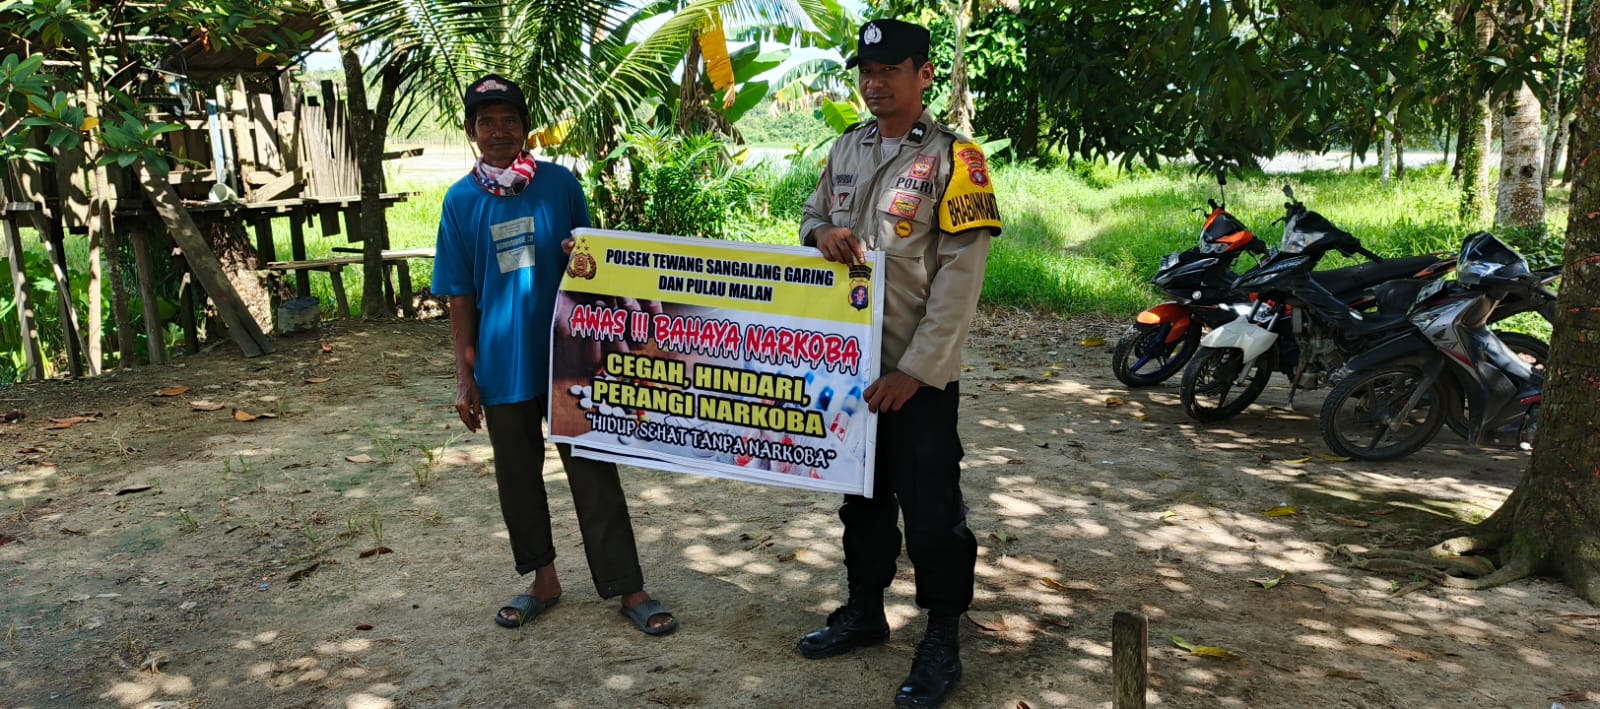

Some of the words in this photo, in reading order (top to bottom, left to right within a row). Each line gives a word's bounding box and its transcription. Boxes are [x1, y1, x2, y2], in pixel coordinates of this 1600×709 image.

[896, 177, 933, 194] POLRI
[606, 249, 650, 267] POLSEK
[653, 254, 703, 273] TEWANG
[706, 259, 781, 280] SANGALANG
[784, 267, 834, 286] GARING
[658, 276, 683, 291] DAN
[686, 279, 726, 297] PULAU
[728, 283, 773, 302] MALAN
[571, 305, 626, 341] AWAS
[653, 315, 741, 359] BAHAYA
[745, 326, 861, 374] NARKOBA
[607, 353, 689, 386] CEGAH,
[695, 364, 809, 404] HINDARI,
[593, 381, 691, 416] PERANGI
[699, 397, 825, 436] NARKOBA
[639, 423, 688, 445] SEHAT
[691, 430, 746, 454] TANPA
